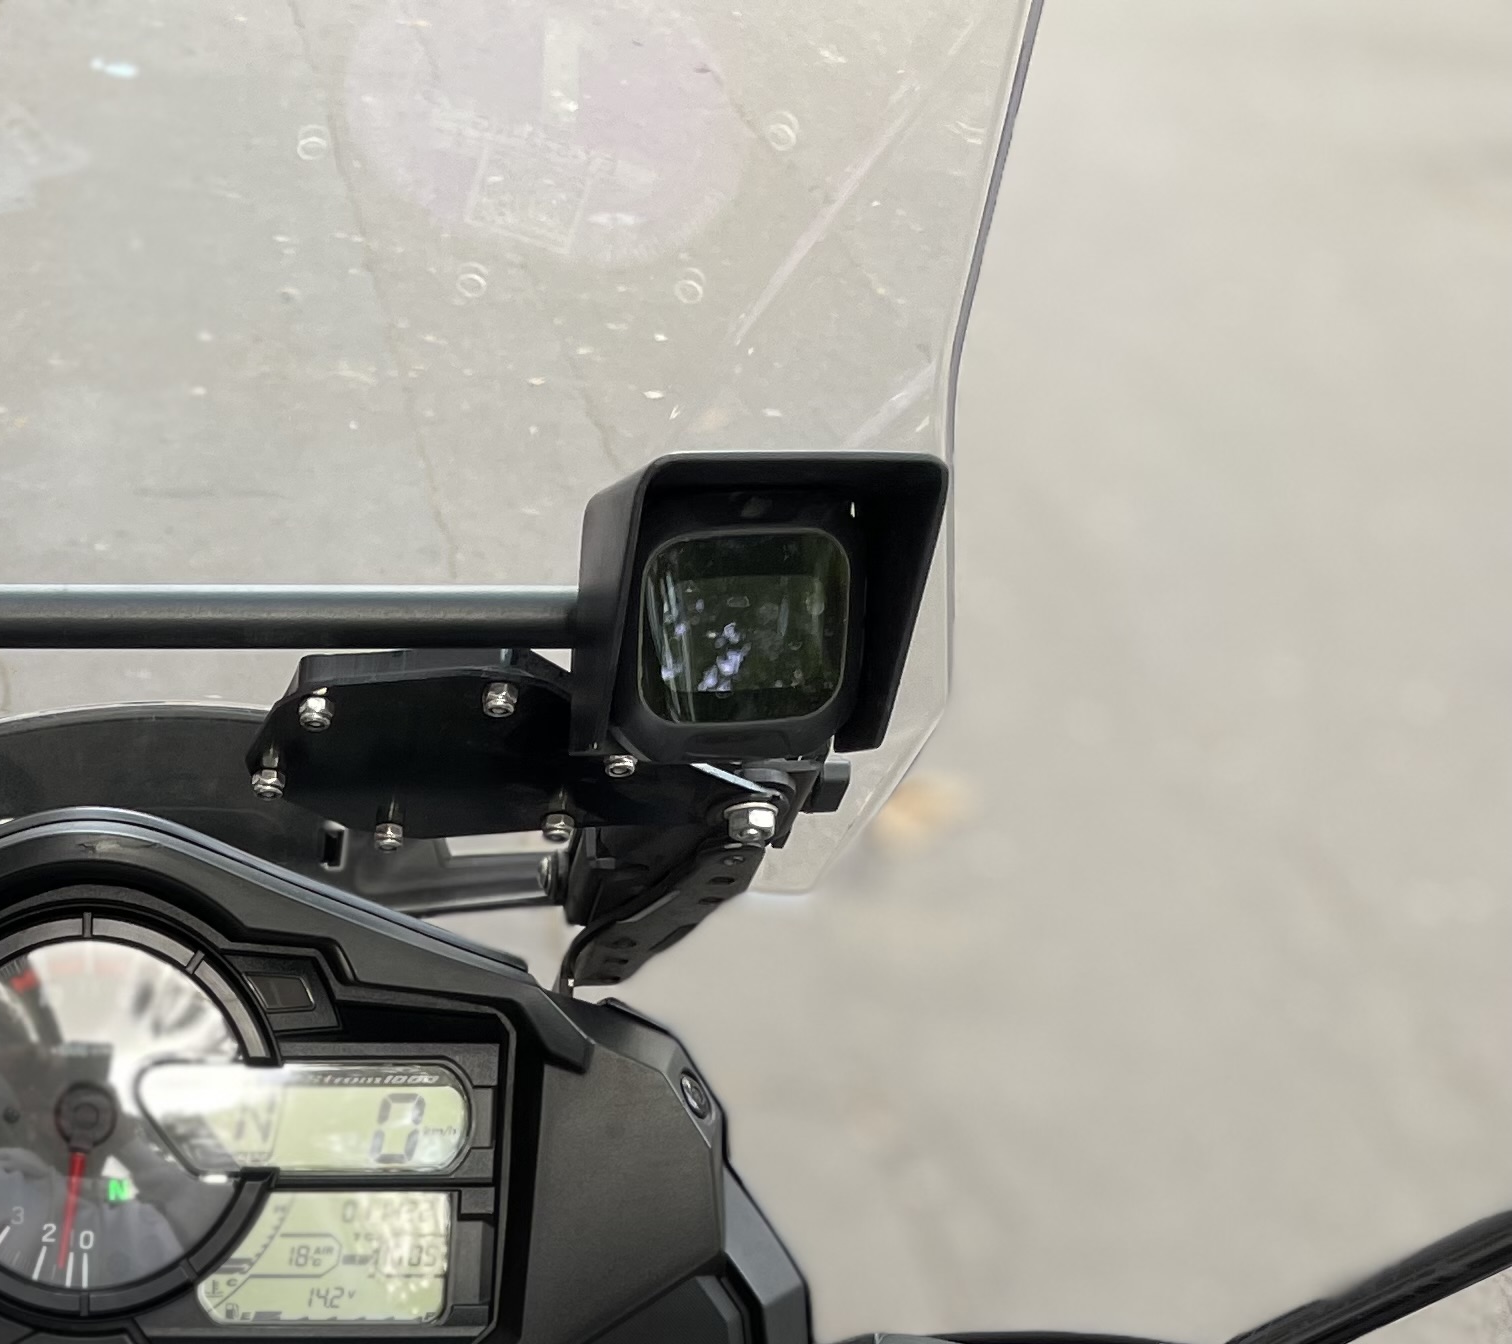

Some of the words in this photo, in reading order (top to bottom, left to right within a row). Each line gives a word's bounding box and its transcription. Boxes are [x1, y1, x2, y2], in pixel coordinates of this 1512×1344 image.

[368, 1092, 426, 1164] 0
[108, 1179, 128, 1201] N
[11, 1206, 24, 1225] 3
[41, 1223, 57, 1242] 2
[79, 1230, 94, 1250] 0
[289, 1246, 309, 1267] 18
[308, 1287, 345, 1309] 14.2
[240, 1312, 252, 1320] E
